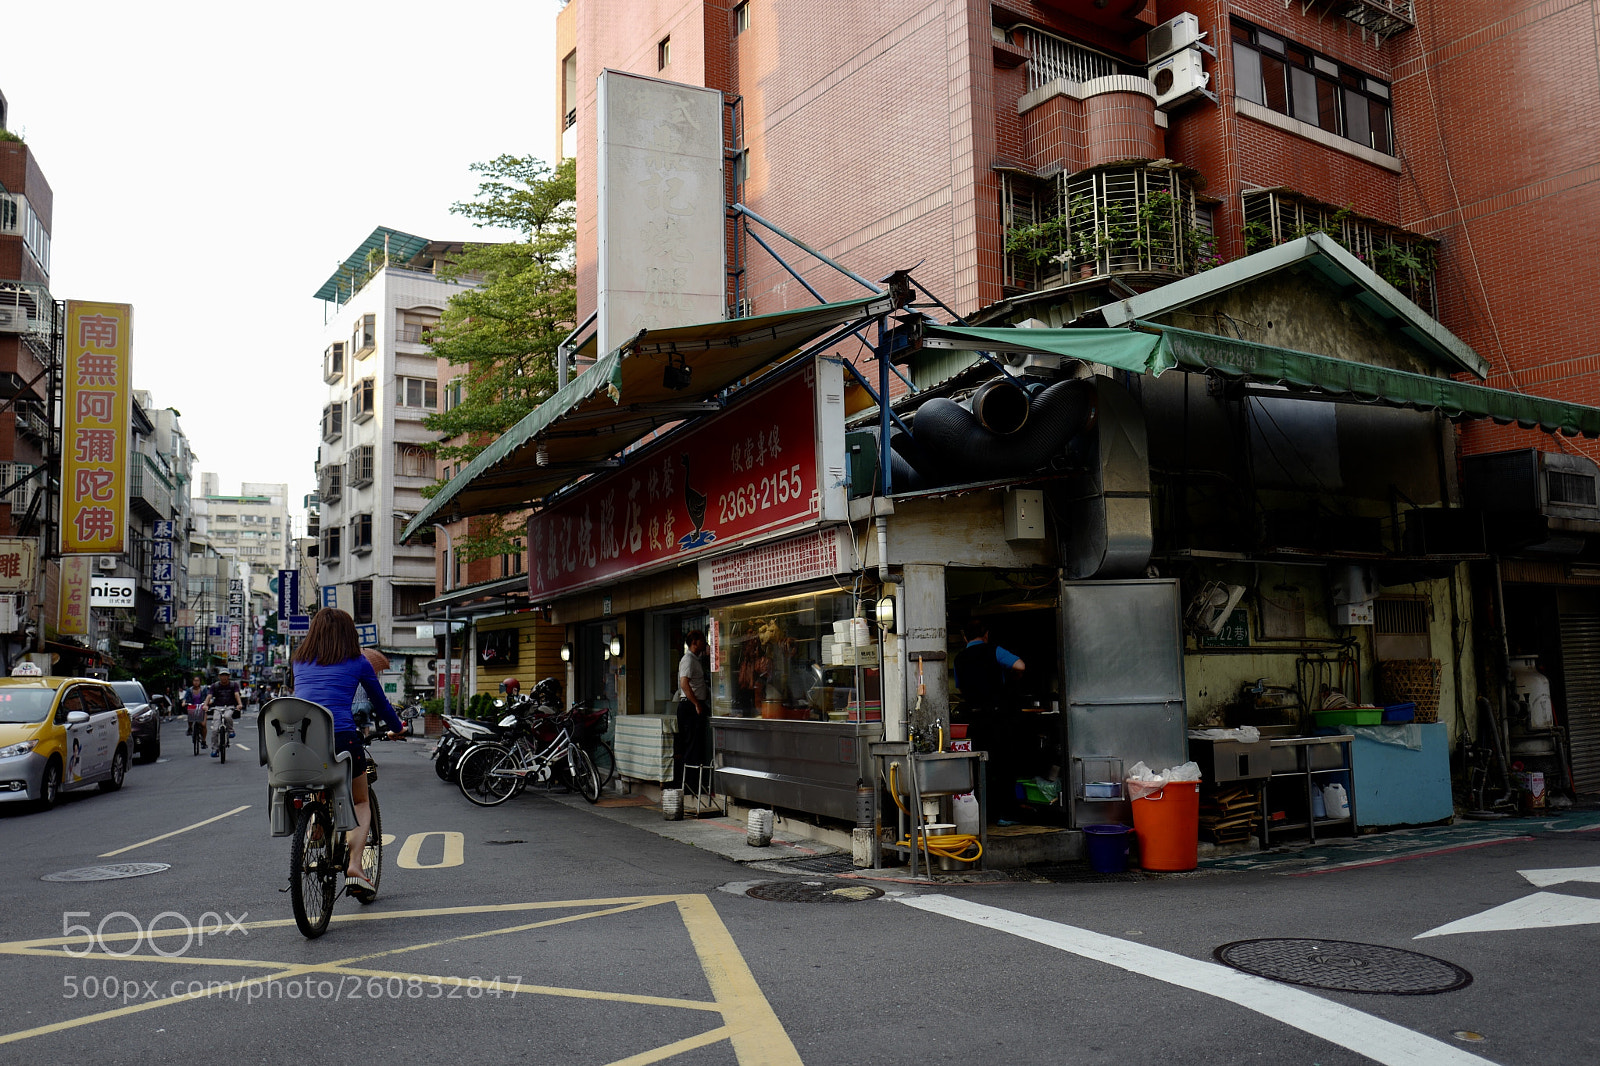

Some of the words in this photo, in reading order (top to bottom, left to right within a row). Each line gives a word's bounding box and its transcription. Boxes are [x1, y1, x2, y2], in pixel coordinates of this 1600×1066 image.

[74, 313, 120, 543] 南無阿彌陀佛
[718, 464, 803, 525] 2363-2155
[647, 508, 676, 552] 便當
[152, 520, 172, 623] 泰順乾洗店
[284, 571, 293, 618] Panasonic
[362, 832, 465, 869] 0
